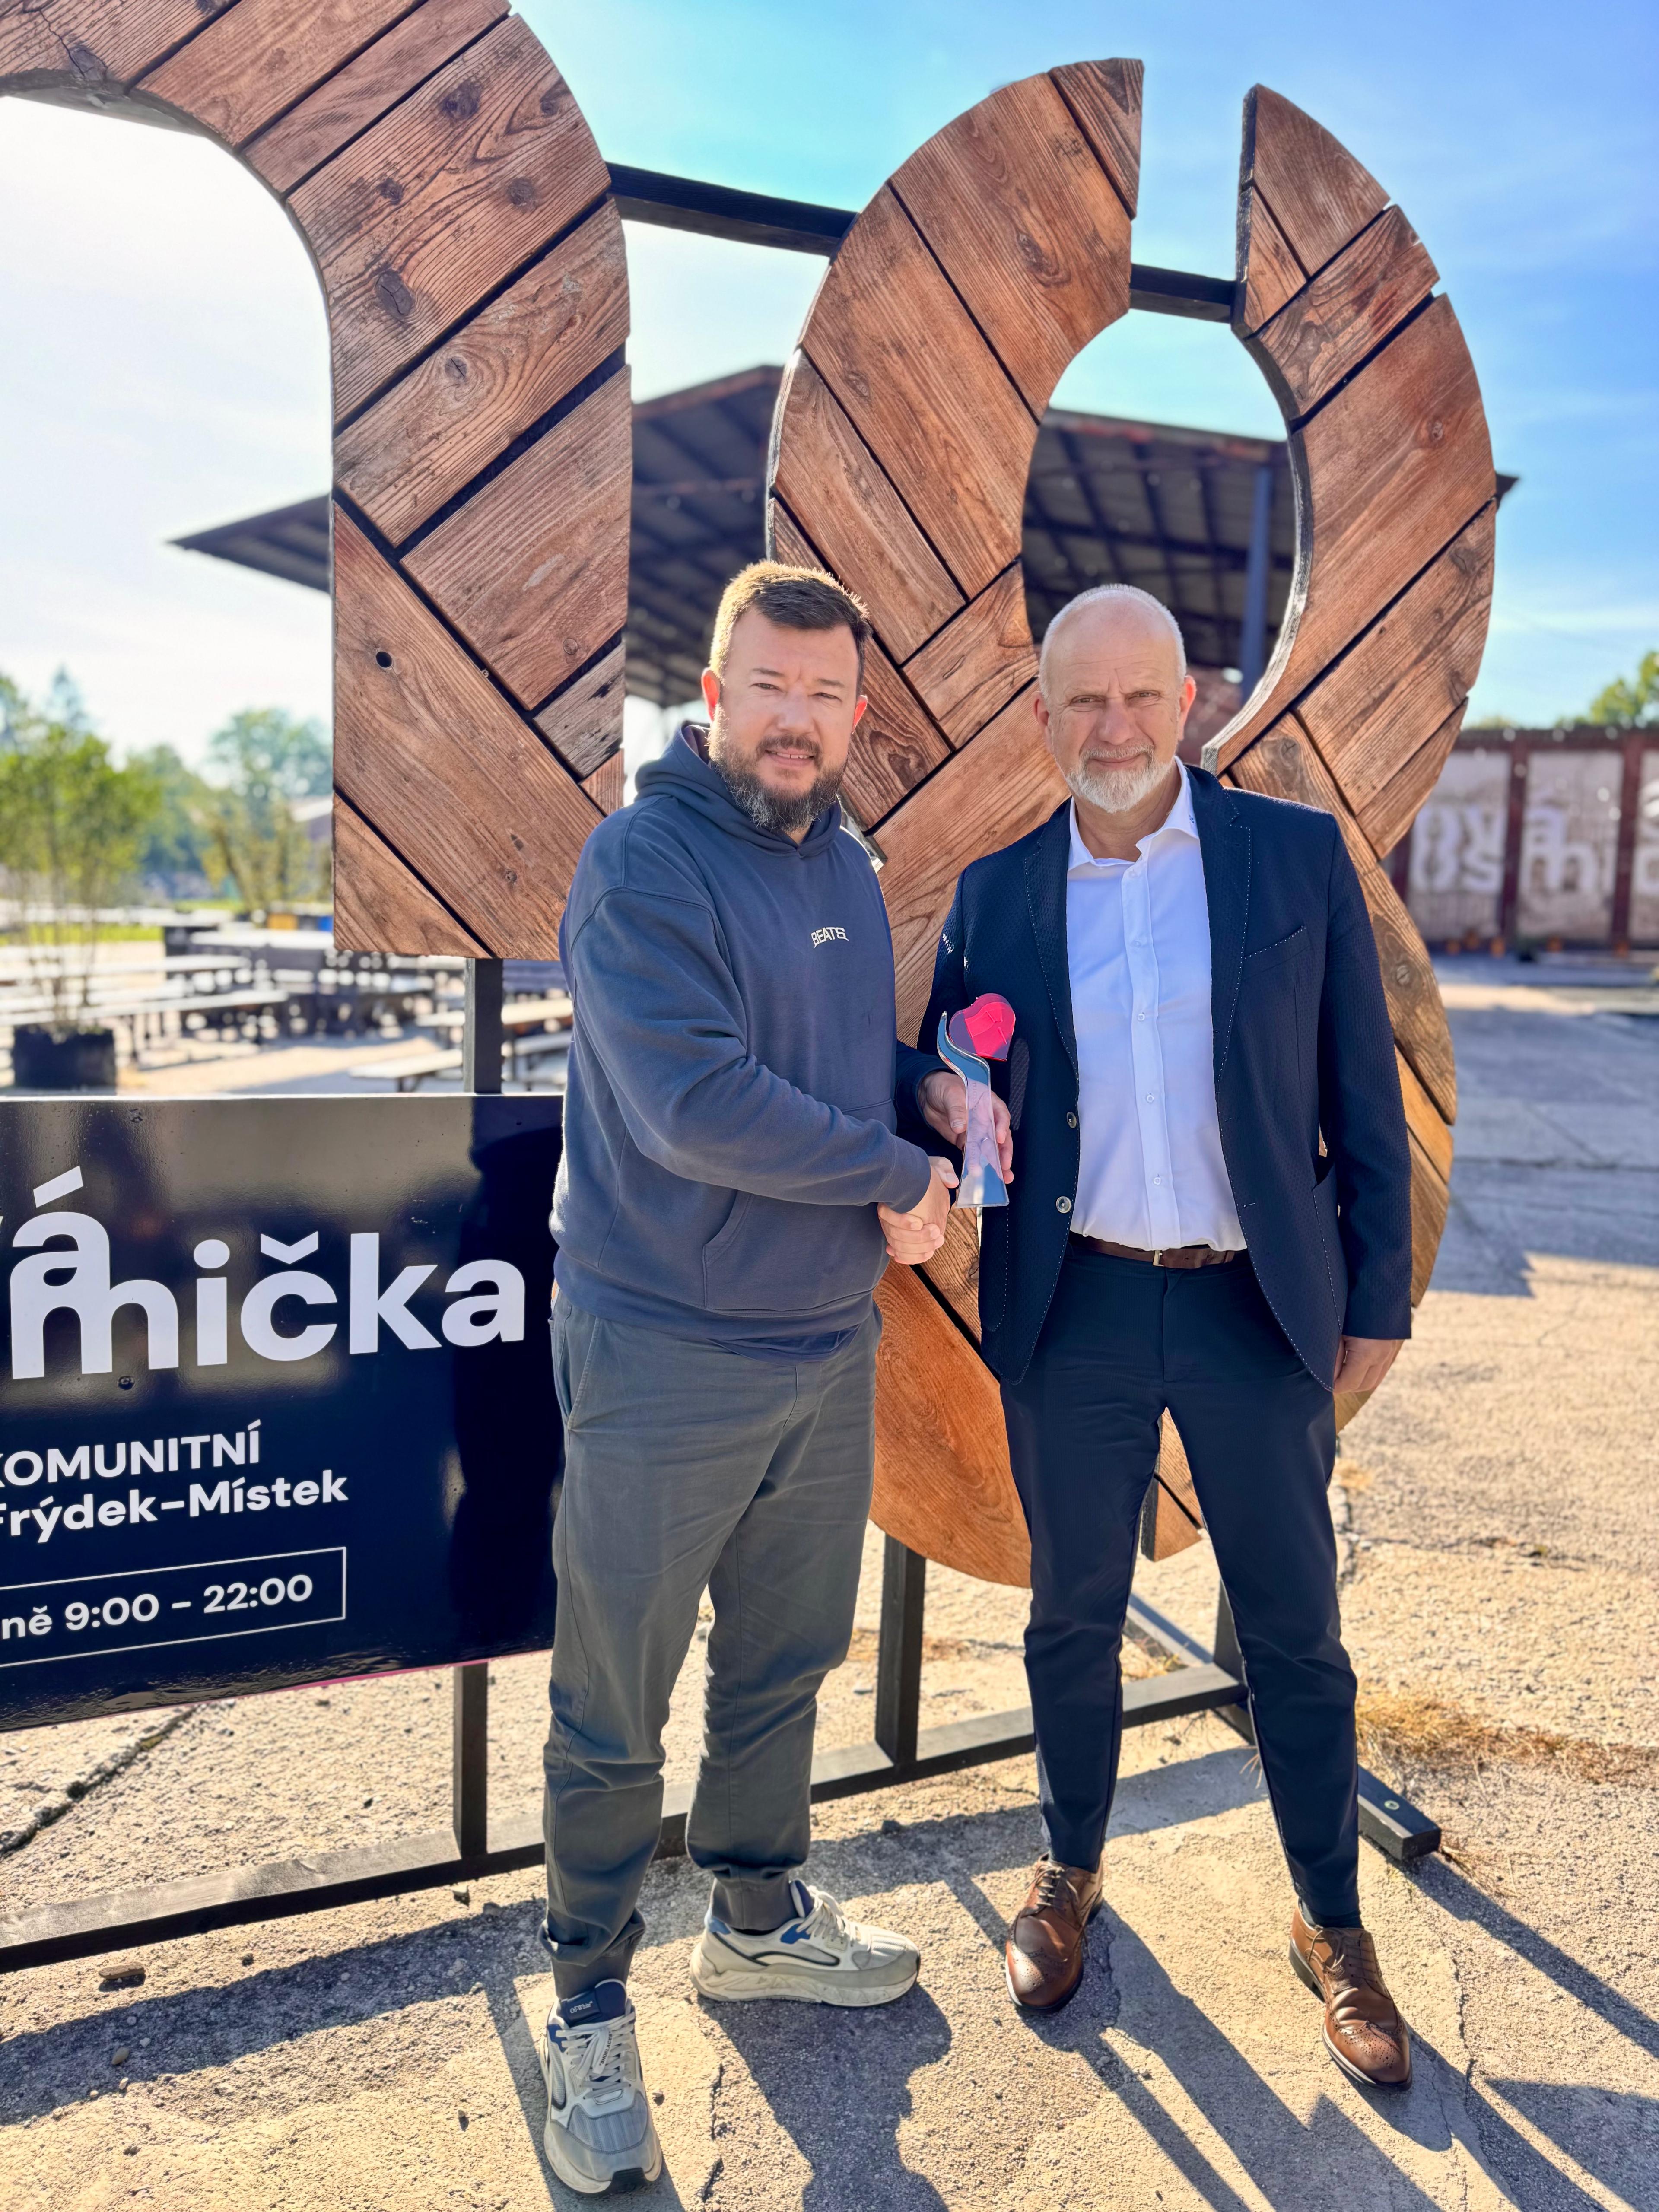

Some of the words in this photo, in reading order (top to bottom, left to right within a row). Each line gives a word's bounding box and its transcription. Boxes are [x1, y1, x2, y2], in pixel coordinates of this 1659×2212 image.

[811, 927, 849, 948] BEATS
[0, 1419, 261, 1487] OMUNITNÍ
[65, 1593, 159, 1630] 9:00
[203, 1574, 313, 1613] 22:00
